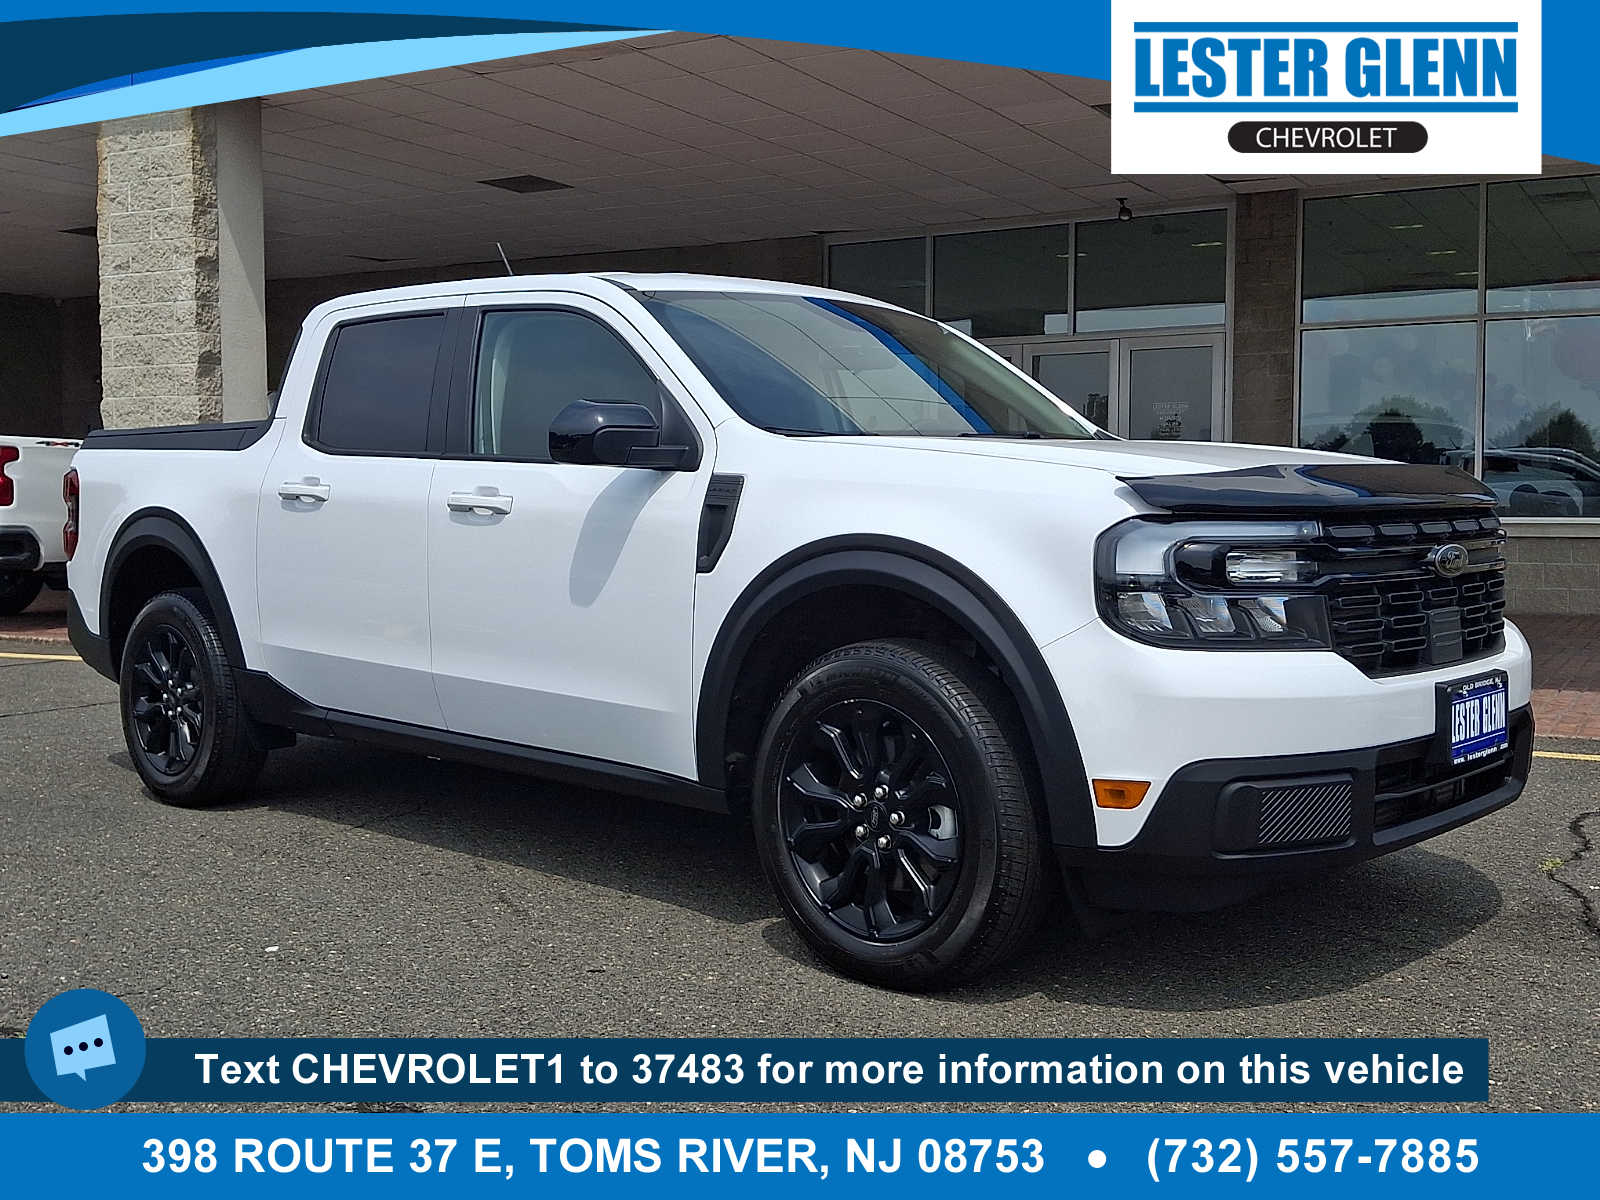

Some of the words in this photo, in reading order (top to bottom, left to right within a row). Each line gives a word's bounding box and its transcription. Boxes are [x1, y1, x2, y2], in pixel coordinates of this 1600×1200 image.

[1462, 683, 1474, 691] OLD
[1451, 699, 1480, 743] LESTER
[1482, 691, 1506, 734] GLENN
